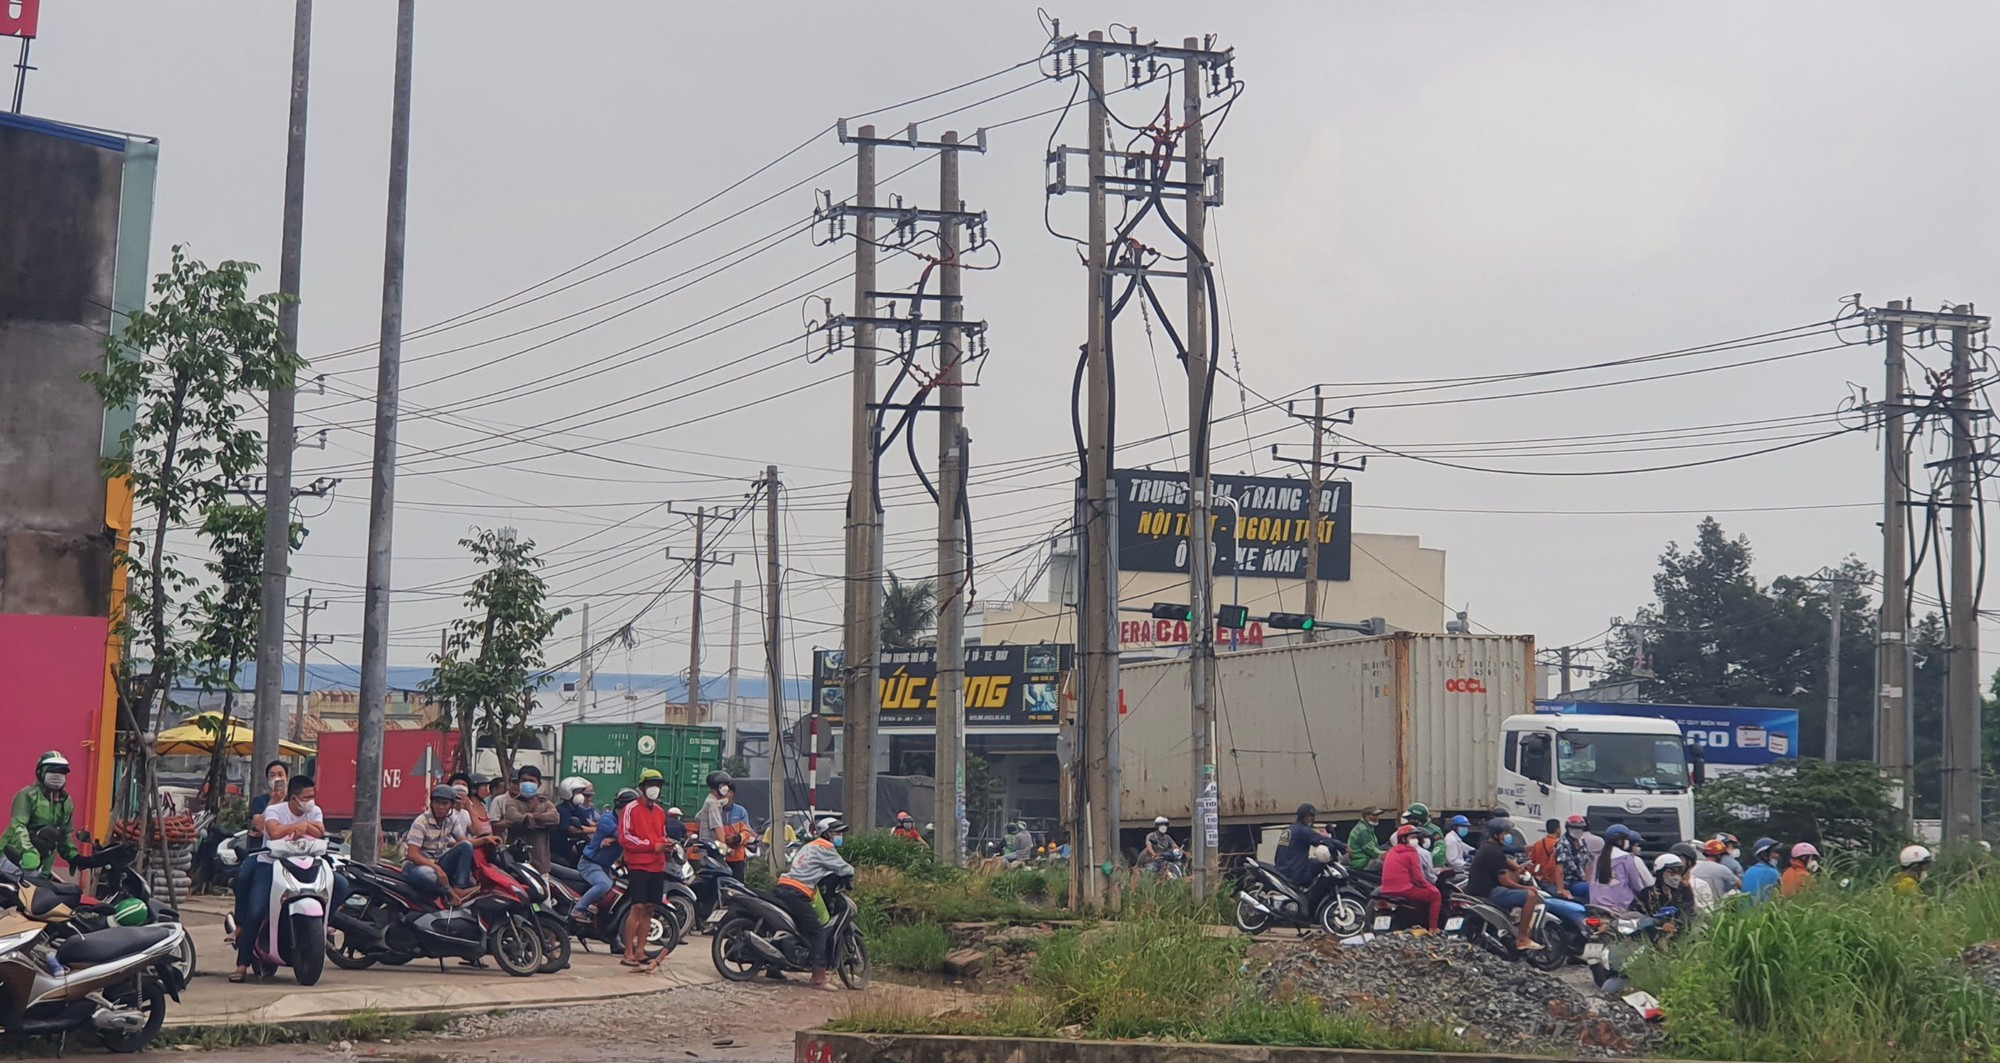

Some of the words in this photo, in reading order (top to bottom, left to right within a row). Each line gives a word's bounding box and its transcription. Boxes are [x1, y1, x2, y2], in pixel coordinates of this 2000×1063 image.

[1129, 479, 1188, 504] TRUNG
[1242, 485, 1303, 511] TRANG
[1309, 487, 1341, 513] RÍ
[1138, 508, 1172, 539] NỘI
[1233, 516, 1291, 545] NGOẠI
[1175, 540, 1187, 567] Ô
[1233, 547, 1259, 571] XE
[1262, 546, 1301, 572] MÁY
[1156, 620, 1263, 645] CAERA
